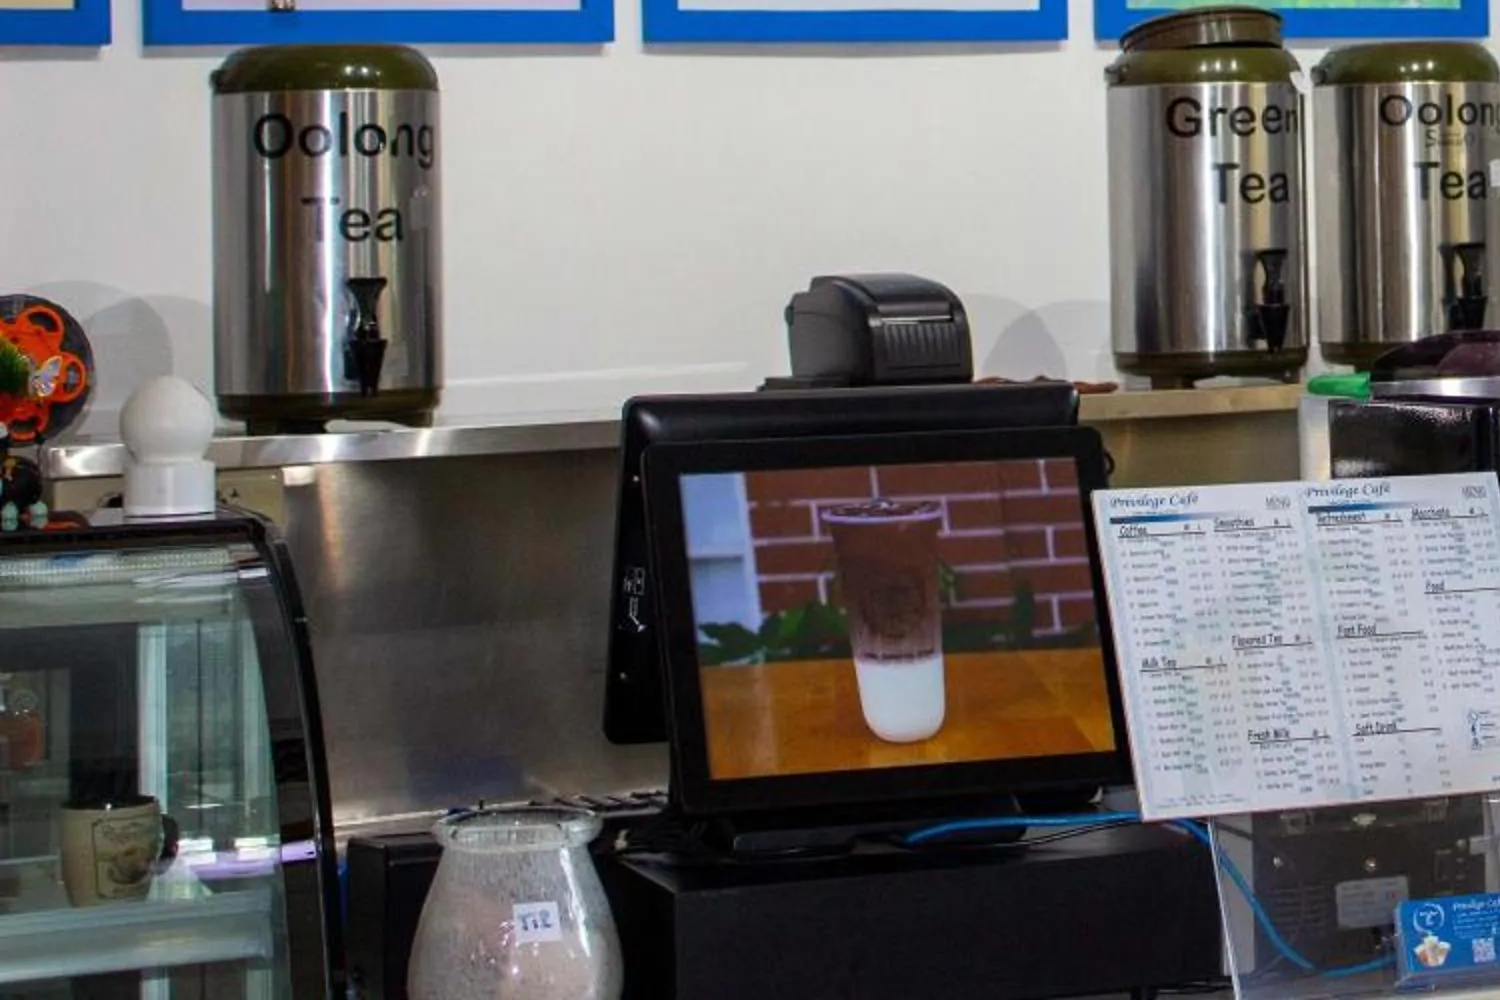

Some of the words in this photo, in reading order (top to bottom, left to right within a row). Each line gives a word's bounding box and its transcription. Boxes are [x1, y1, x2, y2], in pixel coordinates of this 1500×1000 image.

[1166, 96, 1299, 138] Green
[254, 113, 434, 169] Oolong
[1212, 163, 1290, 204] Tea
[1414, 162, 1487, 200] Tea
[301, 196, 404, 242] Tea
